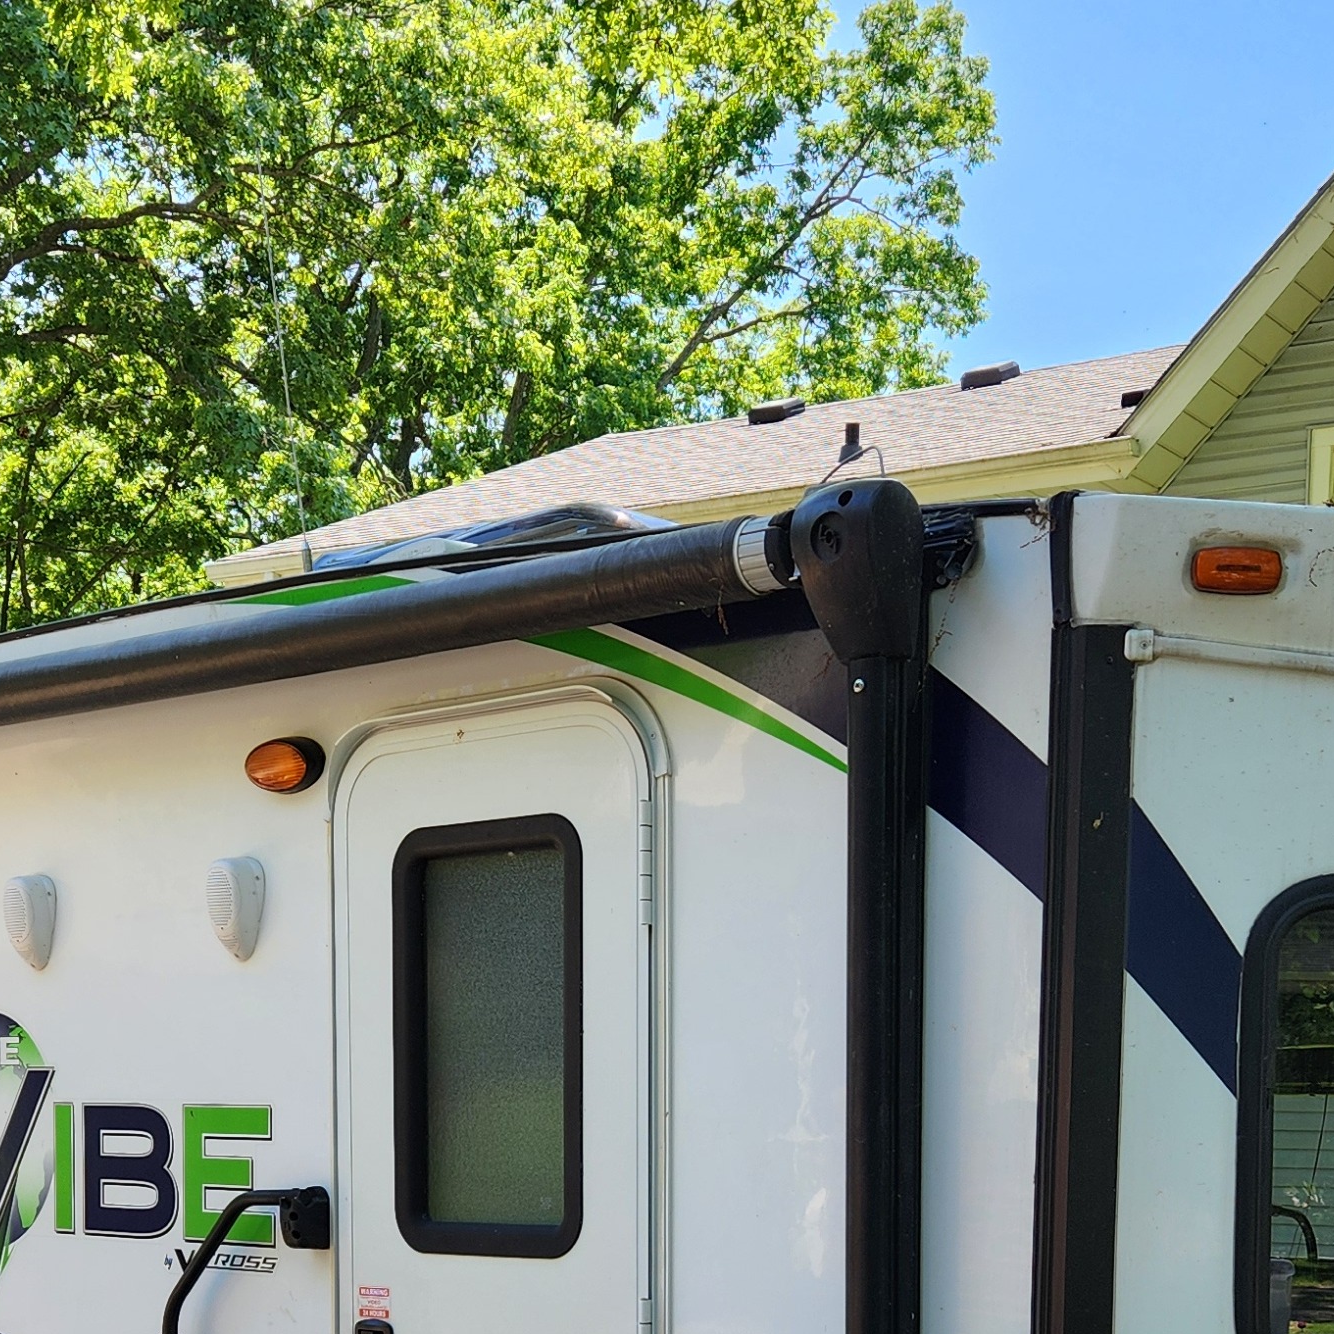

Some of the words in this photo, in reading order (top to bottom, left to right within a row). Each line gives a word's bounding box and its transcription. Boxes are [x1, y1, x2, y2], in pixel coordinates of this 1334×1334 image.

[164, 1253, 173, 1270] by
[174, 1249, 278, 1274] VROSS
[360, 1288, 388, 1296] WARNING
